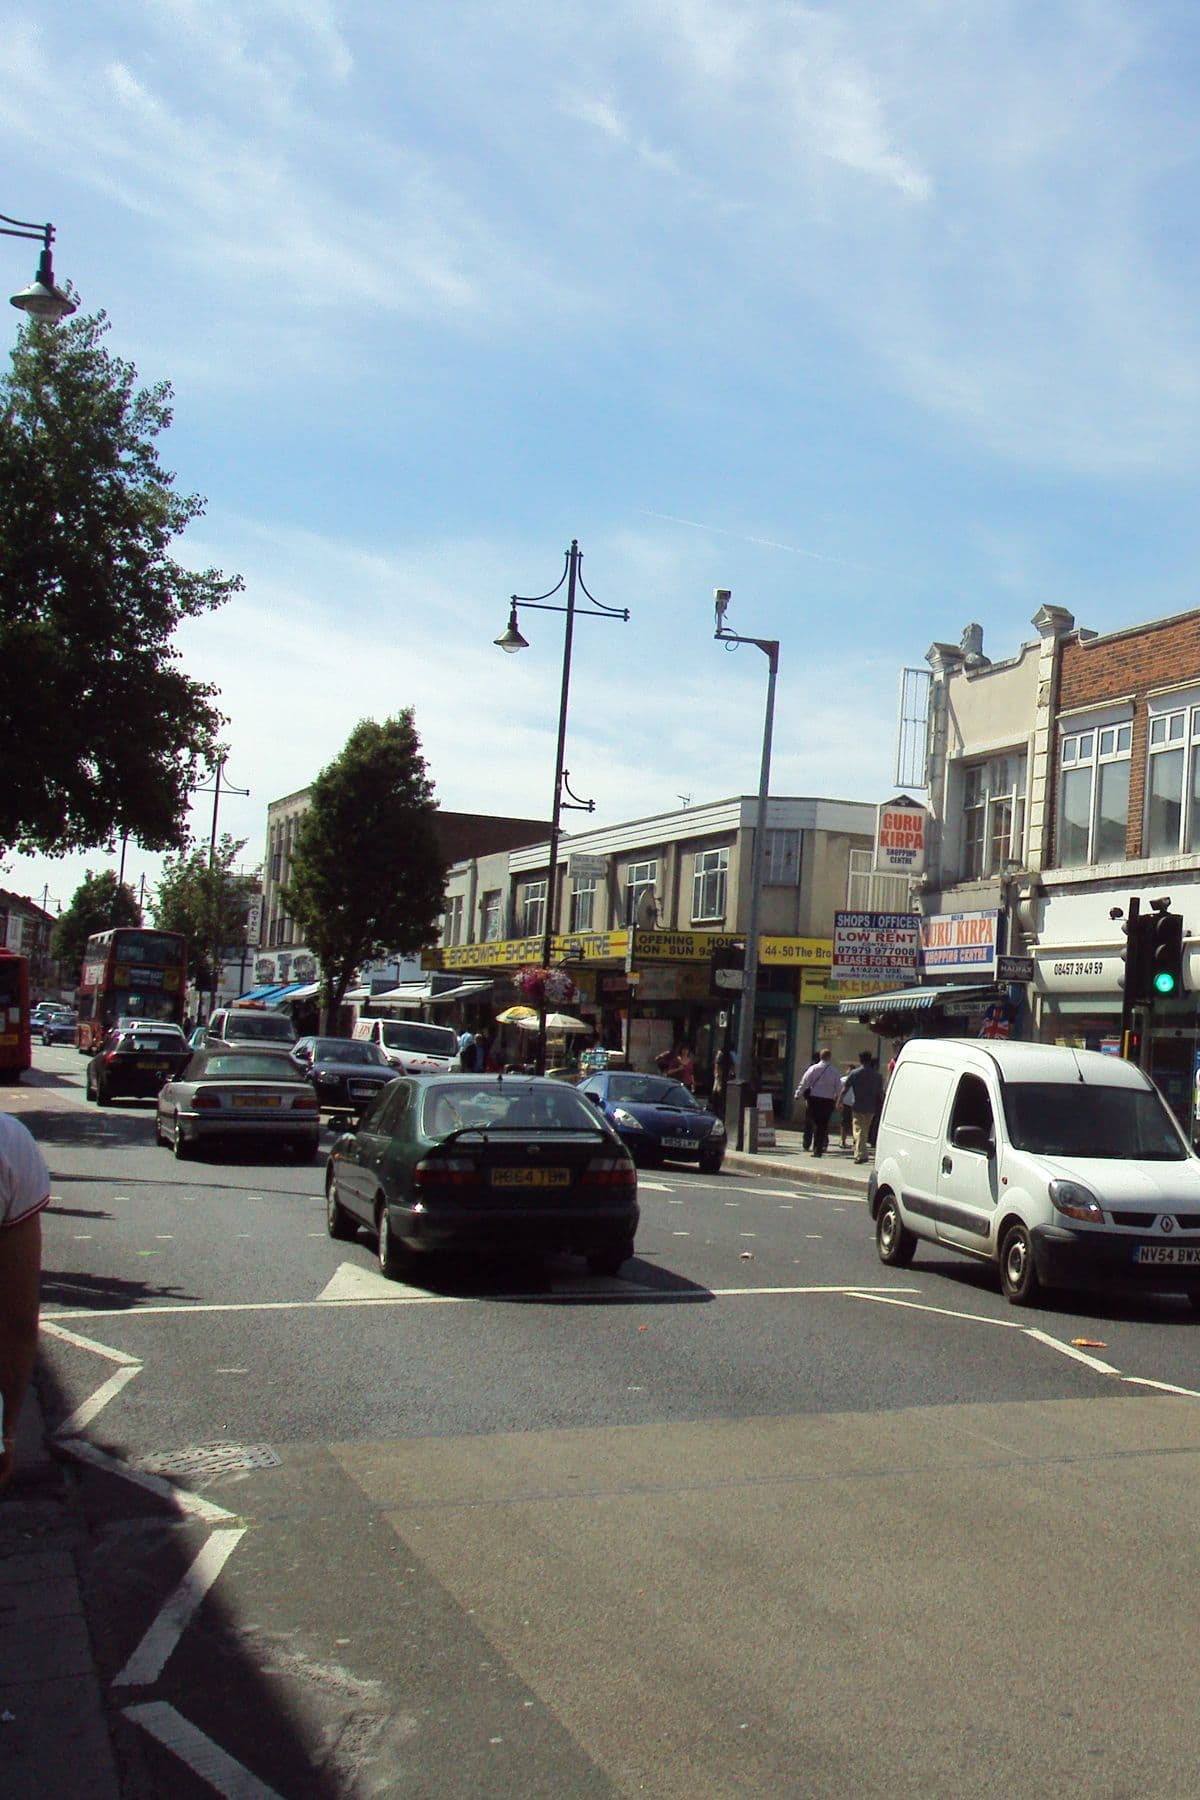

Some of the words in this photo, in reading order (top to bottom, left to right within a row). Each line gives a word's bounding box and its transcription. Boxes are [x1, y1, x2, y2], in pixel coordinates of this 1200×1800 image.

[883, 812, 923, 832] GURU
[880, 831, 923, 850] KIRPA
[886, 848, 917, 857] SHOPPING
[890, 856, 913, 864] CENTRE
[837, 914, 871, 927] SHOPS
[878, 915, 919, 929] OFFICES
[837, 932, 870, 942] LOW
[875, 933, 916, 944] RENT
[921, 921, 953, 948] GURU
[956, 918, 993, 945] KIRPA
[639, 935, 694, 945] OPENING
[505, 938, 556, 961] SHOPPIG
[562, 934, 610, 958] CENTRE
[633, 945, 660, 954] MON
[669, 945, 694, 956] SUN
[794, 947, 813, 958] The
[815, 947, 832, 959] Bro
[838, 946, 872, 954] 07979
[874, 947, 915, 956] 977008
[960, 947, 987, 962] CENTRE
[838, 955, 866, 965] LEASE
[869, 956, 888, 966] FOR
[890, 957, 914, 967] SALE
[1001, 965, 1032, 973] HALIFAX
[1054, 962, 1074, 976] 08457
[1074, 962, 1084, 975] 39
[1084, 962, 1094, 975] 49
[1094, 961, 1103, 975] 59
[1140, 1247, 1175, 1261] NV54
